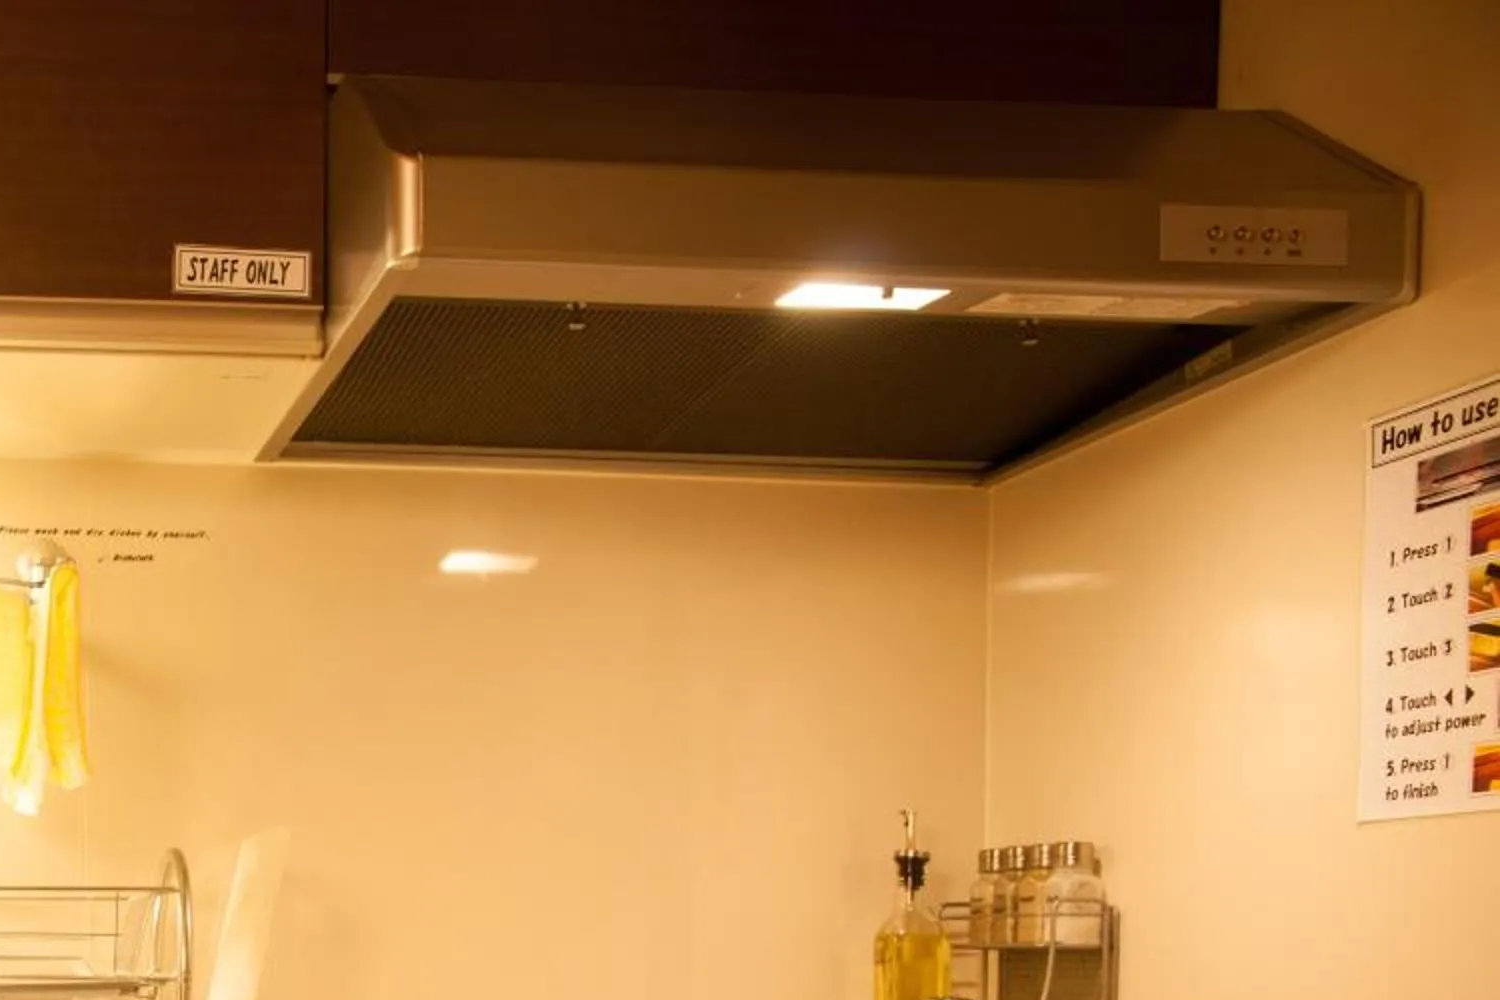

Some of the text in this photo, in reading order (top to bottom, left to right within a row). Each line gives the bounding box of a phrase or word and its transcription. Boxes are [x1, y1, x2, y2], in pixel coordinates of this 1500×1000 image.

[186, 256, 291, 286] STAFF ONLY
[1381, 396, 1500, 455] How to use
[1401, 543, 1439, 563] Press
[1446, 535, 1452, 553] 1
[1401, 586, 1438, 609] Touch
[1443, 582, 1453, 600] 2
[1400, 641, 1438, 663] Touch
[1444, 638, 1453, 656] 3
[1399, 690, 1437, 712] Touch
[1385, 712, 1487, 740] to adjust power
[1400, 757, 1437, 775] Press
[1444, 751, 1450, 770] 1
[1385, 780, 1440, 801] to finish
